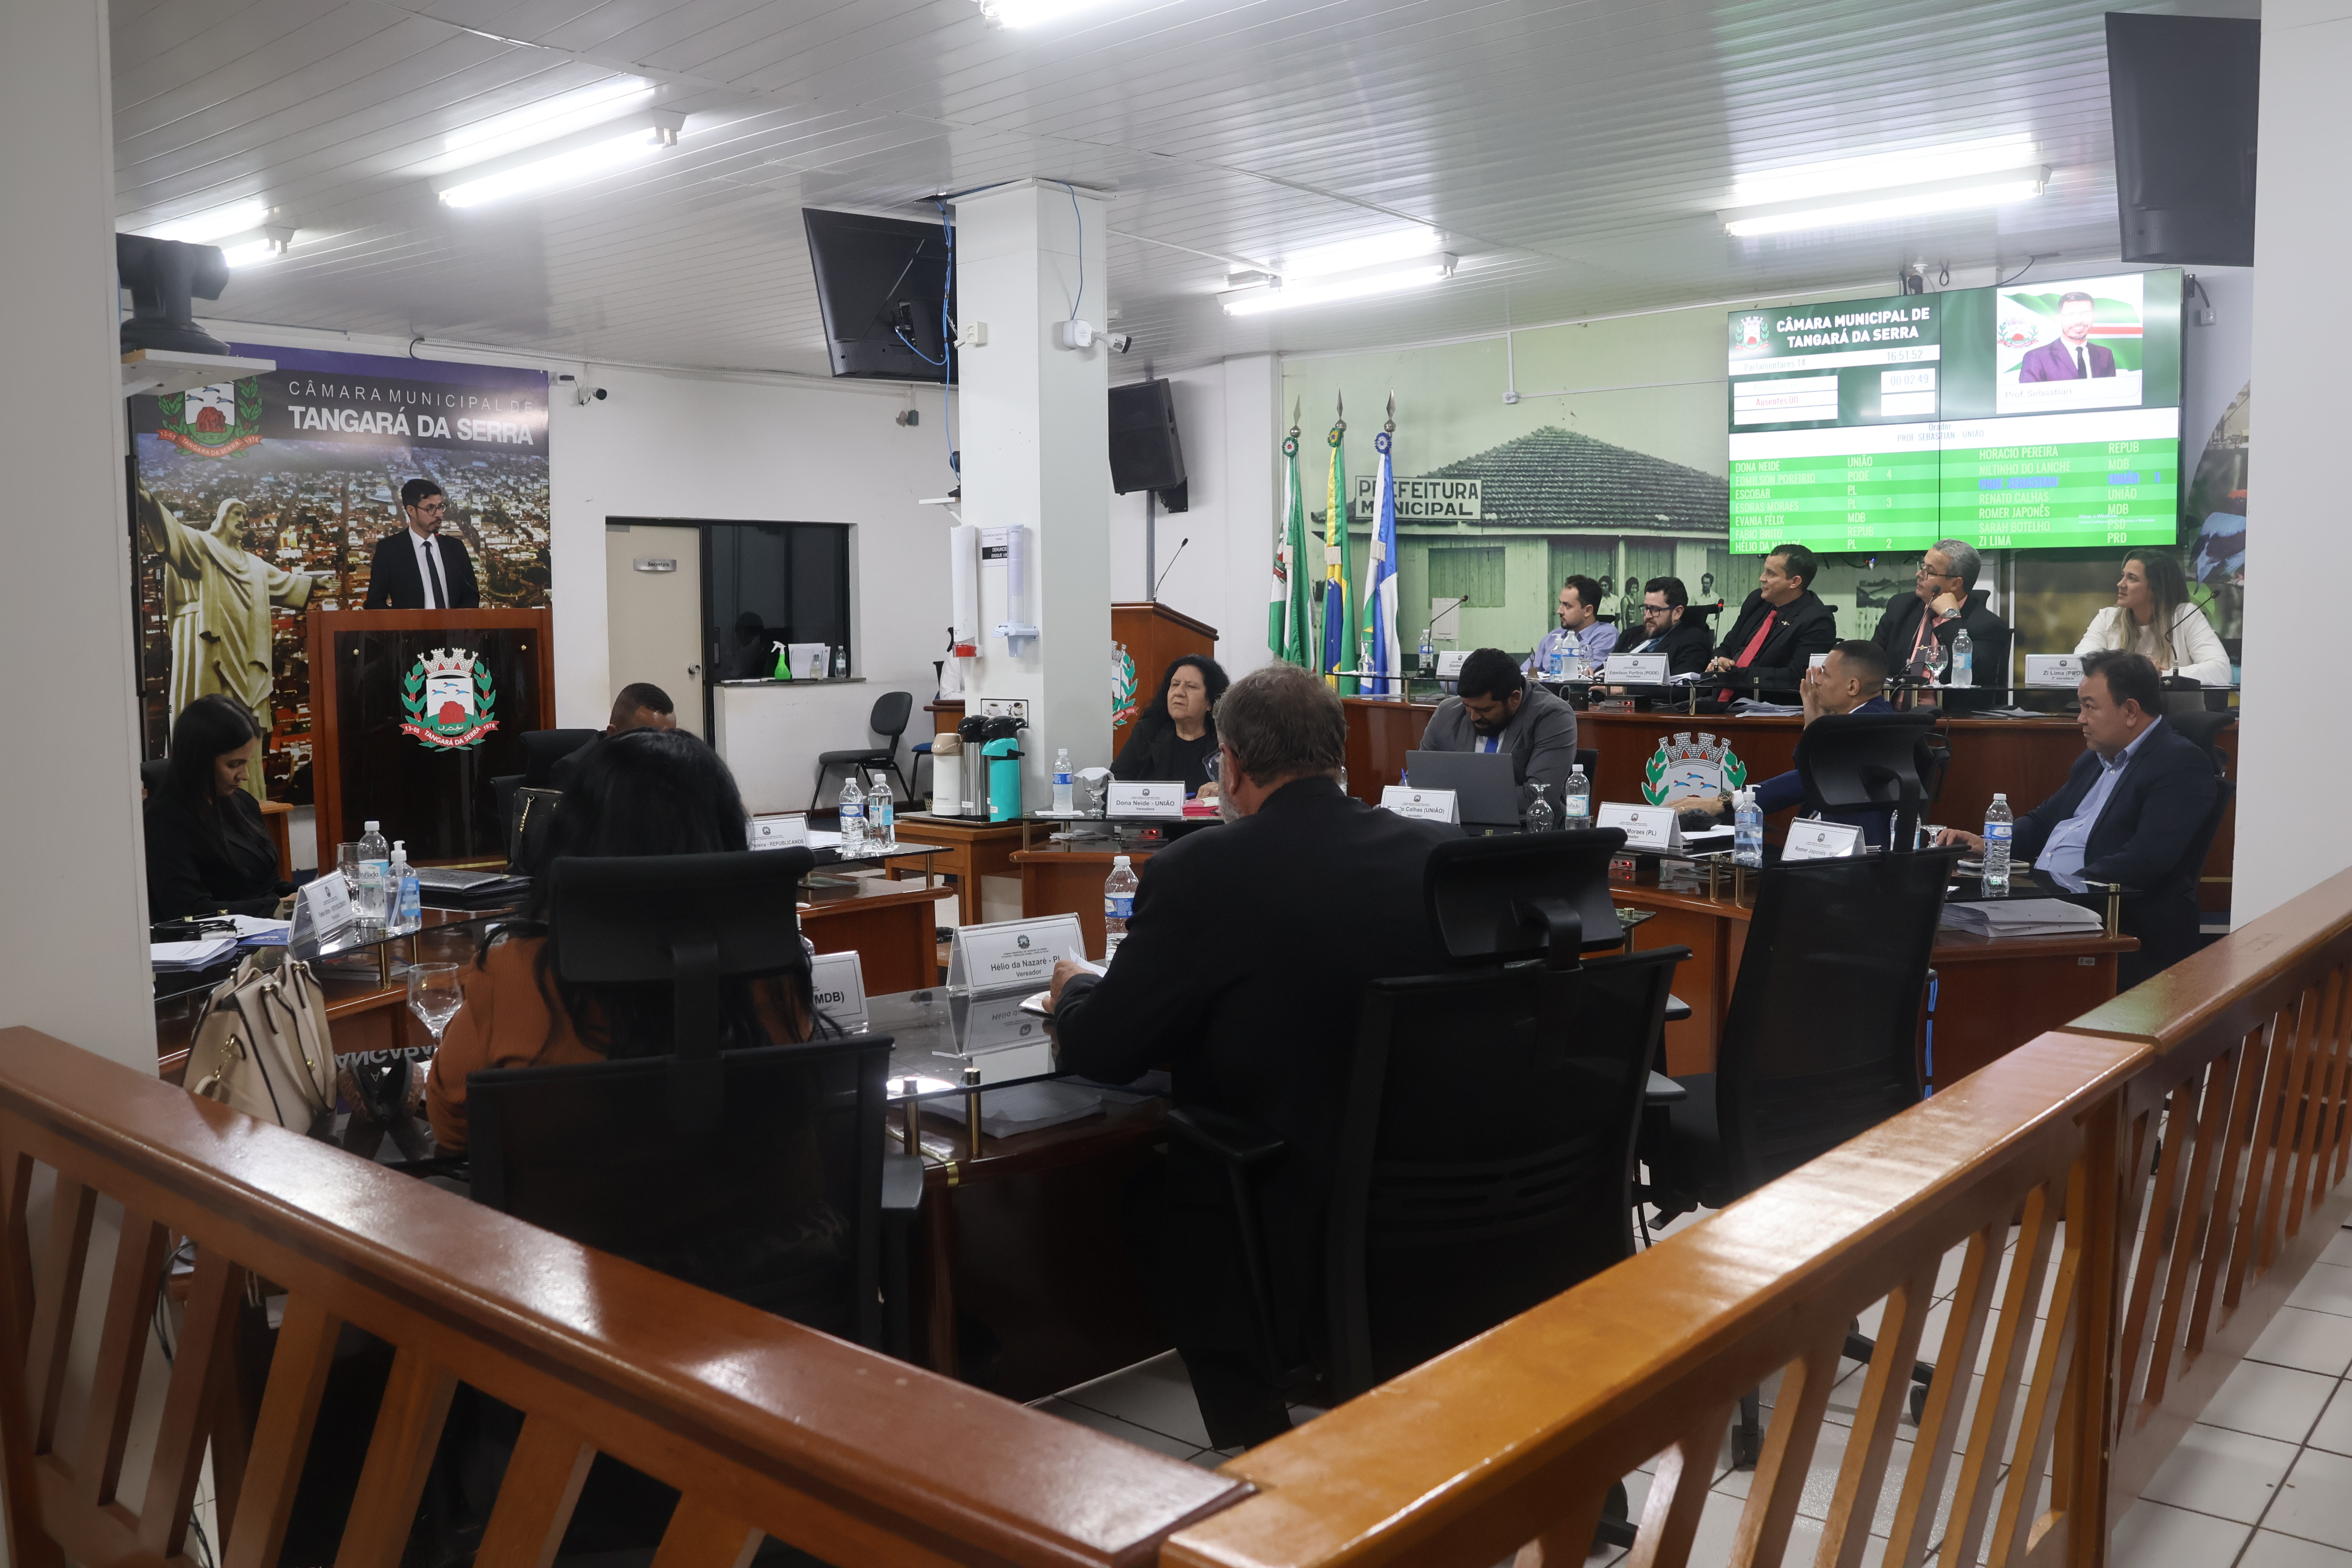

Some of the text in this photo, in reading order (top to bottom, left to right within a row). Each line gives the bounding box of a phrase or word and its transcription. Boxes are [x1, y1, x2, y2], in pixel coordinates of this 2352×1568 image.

[1776, 307, 1930, 333] CÂMARA MUNICIPAL DE
[1787, 326, 1919, 348] TANGARÁ DA SERRA
[1887, 349, 1923, 361] 16:51:52
[1744, 359, 1806, 372] Parlamentares 14
[1890, 374, 1929, 386] 00:02:49
[1753, 381, 1798, 392] Presentes 14
[289, 380, 532, 414] CÂMARA MUNICIPAL DE
[2005, 388, 2072, 399] Prof. Sebastian
[1756, 395, 1798, 407] Ausentes 00
[288, 405, 534, 445] TANGARÁ DA SERRA
[1929, 423, 1951, 431] Orador
[160, 431, 176, 441] 13-05
[245, 436, 260, 445] 1976
[1918, 432, 1955, 441] SEBASTIAN
[1962, 428, 1984, 438] UNIÃO
[220, 441, 241, 454] SERRA
[1979, 445, 2058, 460] HORACIO PEREIRA
[2108, 441, 2140, 454] REPUB
[1735, 461, 1780, 473] DONA NEIDE
[1847, 454, 1873, 468] UNIÃO
[2108, 459, 2130, 470] MDB
[1979, 461, 2071, 475] NILTINHO DO LANCHE
[1735, 473, 1816, 486] EDMILSON PORFIRIO
[1847, 470, 1869, 482] PODE
[1886, 470, 1892, 480] 4
[2108, 470, 2140, 485] UNIÃO
[2154, 472, 2160, 483] 1
[1979, 476, 2058, 490] PROF. SEBASTIAN
[1359, 480, 1479, 499] PFEITURA
[1735, 488, 1771, 500] ESCOBAR
[1847, 485, 1857, 496] PL
[2108, 486, 2137, 499] UNIÃO
[1847, 499, 1857, 510] PL
[1886, 497, 1892, 508] 3
[1979, 492, 2049, 505] RENATO CALHAS
[1361, 501, 1474, 515] MNICIPAL
[1735, 501, 1799, 513] ESDRAS MORAES
[1979, 503, 2050, 519] ROMER JAPONÊS
[2107, 503, 2129, 515] MDB
[1735, 512, 1784, 527] EVANIA FÉLIX
[1847, 512, 1866, 523] MDB
[1979, 521, 2051, 533] SARAH BOTELHO
[2107, 518, 2126, 530] PSD
[1735, 528, 1782, 540] FABIO BRITO
[1847, 526, 1874, 537] REPUB
[1886, 538, 1892, 548] 2
[1979, 535, 2012, 546] ZI LIMA
[2107, 532, 2127, 544] PRD
[1735, 539, 1757, 552] HÉLIO
[1759, 541, 1769, 551] DA
[1847, 539, 1857, 550] PL
[405, 726, 420, 734] 13-05
[424, 730, 454, 746] TANGARÁ
[464, 727, 481, 742] SERRA
[991, 962, 1010, 971] Hélio
[1022, 957, 1047, 967] Nazaré
[1016, 969, 1042, 977] Vereador
[814, 991, 844, 1004] MDB)
